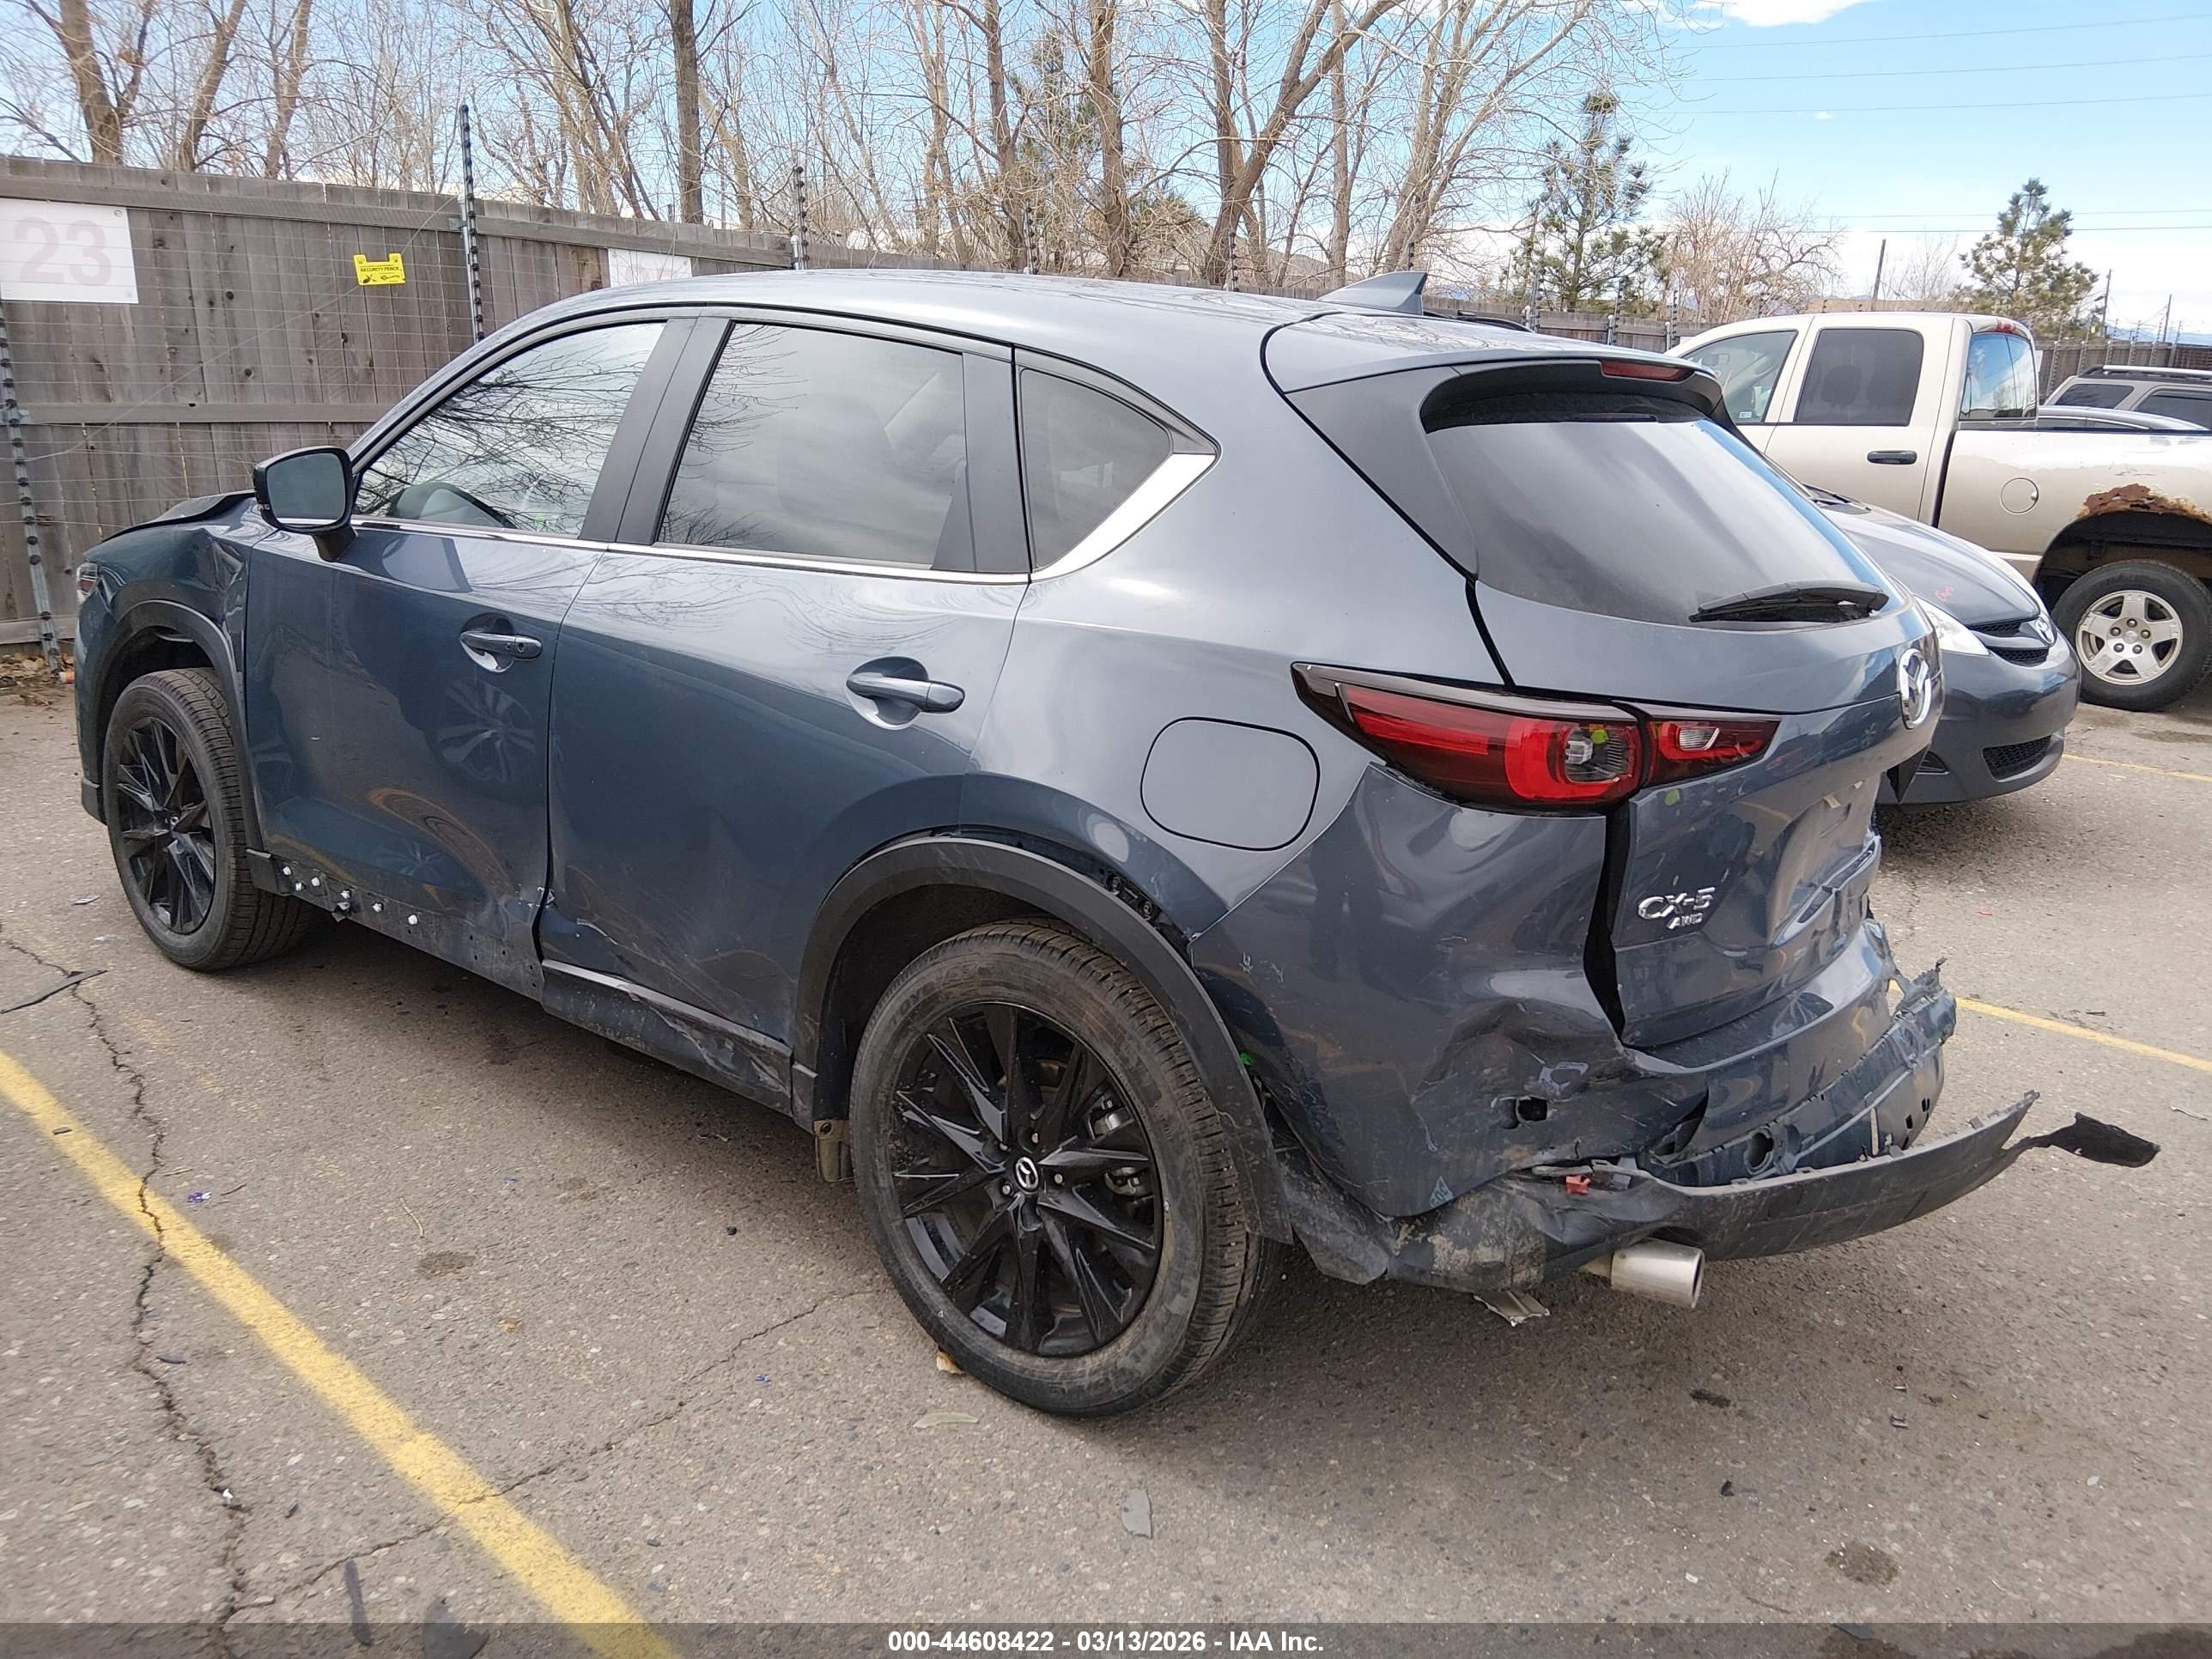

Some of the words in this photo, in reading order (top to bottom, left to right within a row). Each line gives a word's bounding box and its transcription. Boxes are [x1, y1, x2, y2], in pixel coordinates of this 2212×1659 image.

[13, 217, 112, 286] 23
[1638, 886, 1717, 920] CX-5
[1667, 912, 1704, 930] AWD
